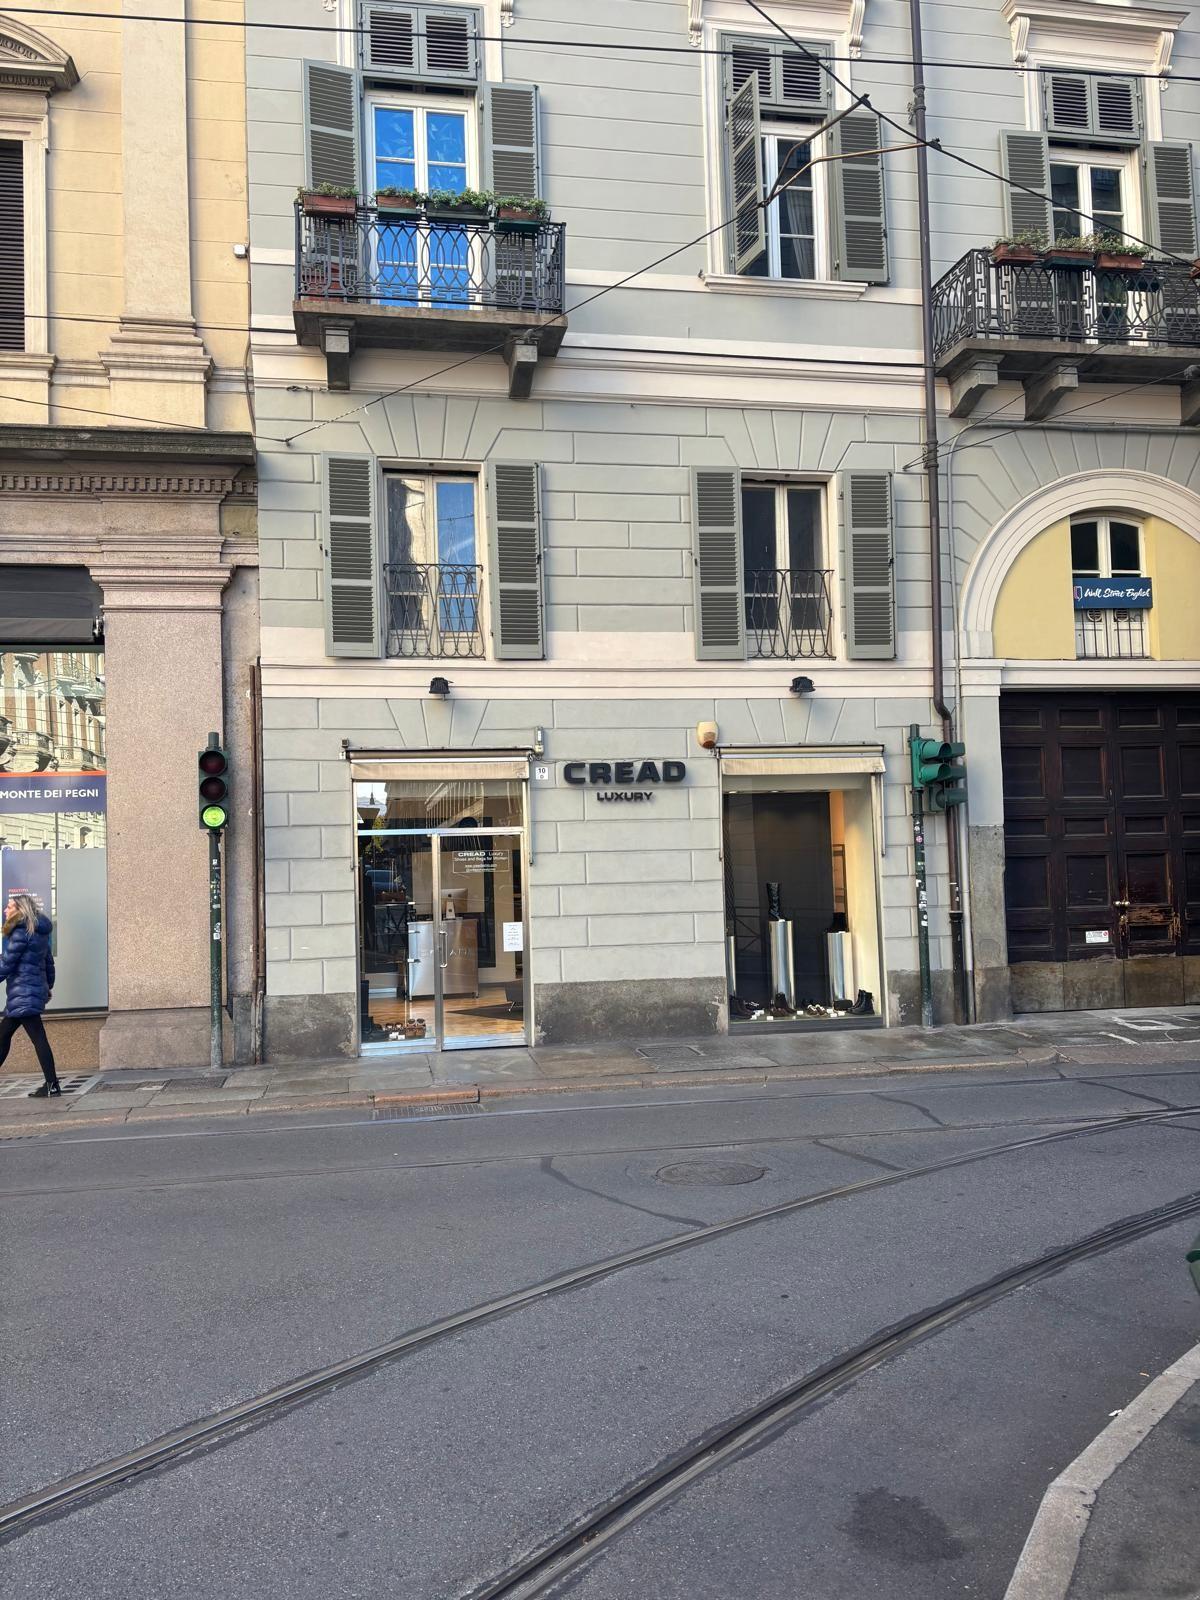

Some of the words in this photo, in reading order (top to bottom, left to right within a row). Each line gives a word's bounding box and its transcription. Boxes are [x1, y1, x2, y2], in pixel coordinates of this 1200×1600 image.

[1084, 588, 1102, 598] Wall
[1103, 588, 1125, 598] Street
[1126, 588, 1151, 600] English
[564, 761, 686, 784] CREAD
[0, 790, 41, 799] MONTE
[44, 789, 62, 798] DEI
[65, 788, 99, 798] PEGNI
[597, 791, 653, 802] LUXURY
